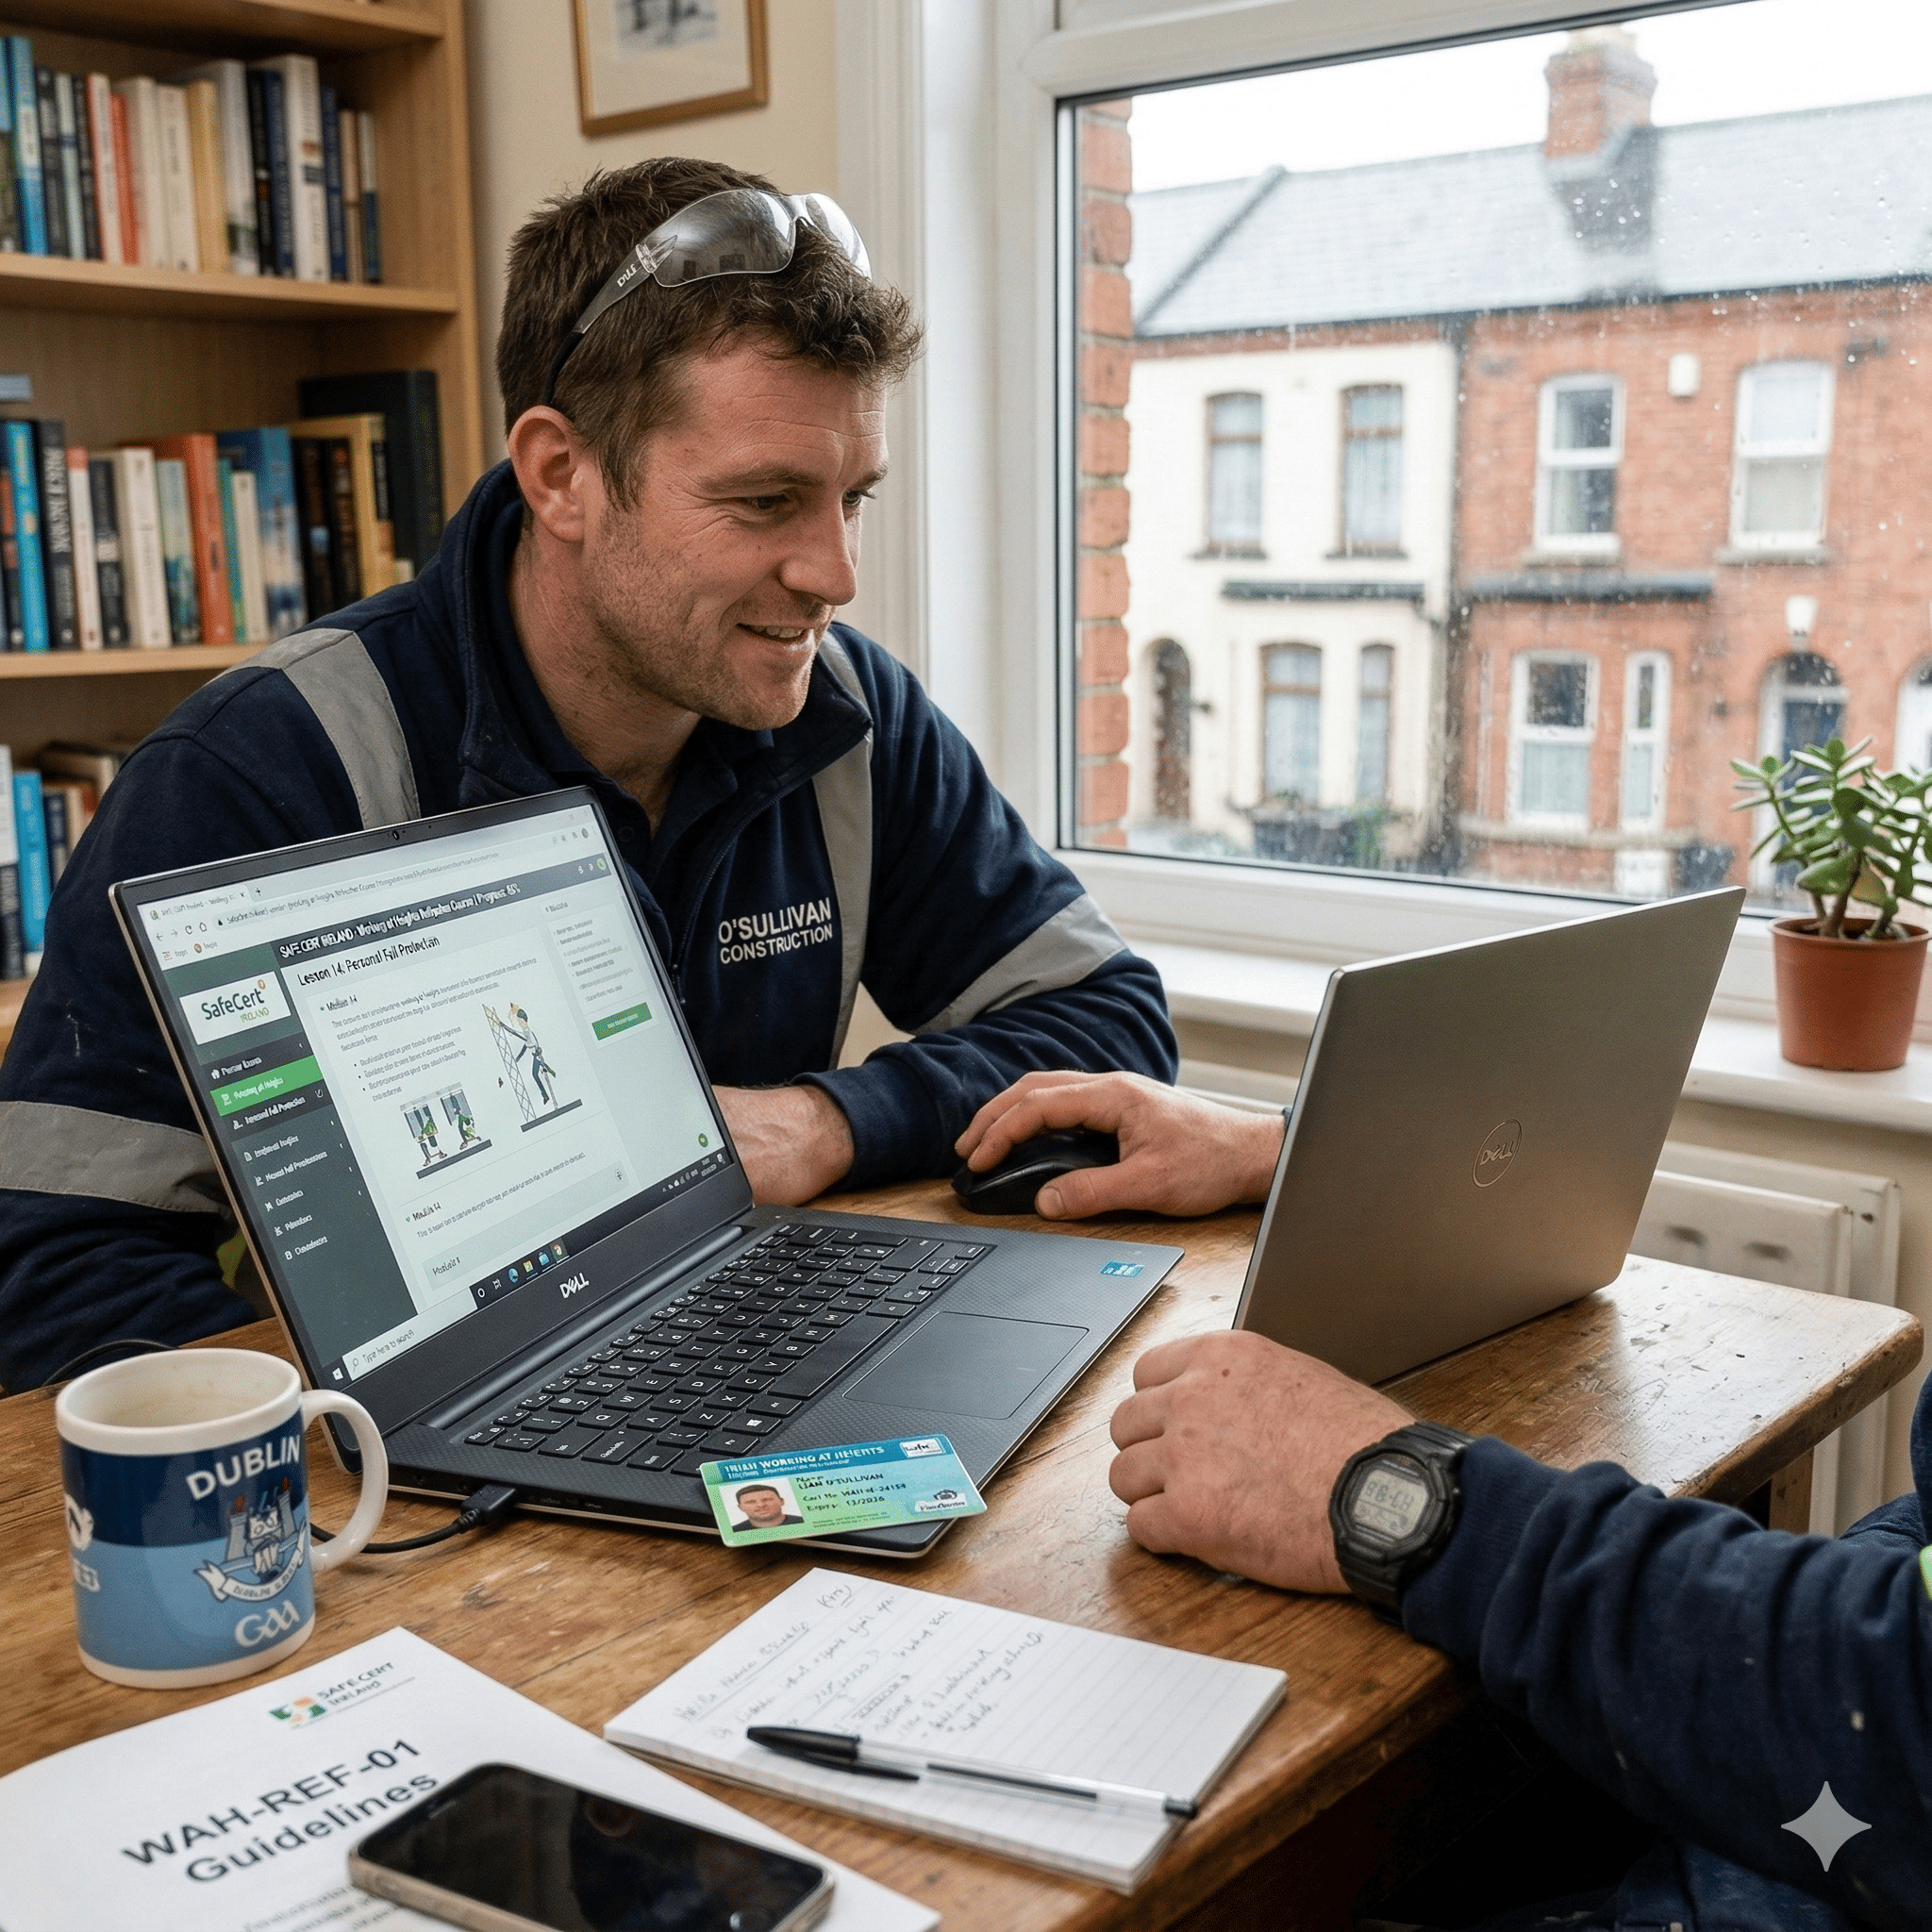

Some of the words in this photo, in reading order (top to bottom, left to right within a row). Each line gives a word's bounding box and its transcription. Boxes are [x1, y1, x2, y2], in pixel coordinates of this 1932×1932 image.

[718, 897, 831, 944] O'SULLIVAN
[720, 923, 833, 964] CONSTRUCTION
[201, 988, 265, 1021] SafeCert
[1479, 1141, 1514, 1166] DELL
[559, 1272, 590, 1299] DELL
[186, 1434, 301, 1501] DUBLIN
[317, 1677, 359, 1700] SAFE
[121, 1737, 422, 1867] WAH-REF-01
[185, 1770, 441, 1885] Guidelines
